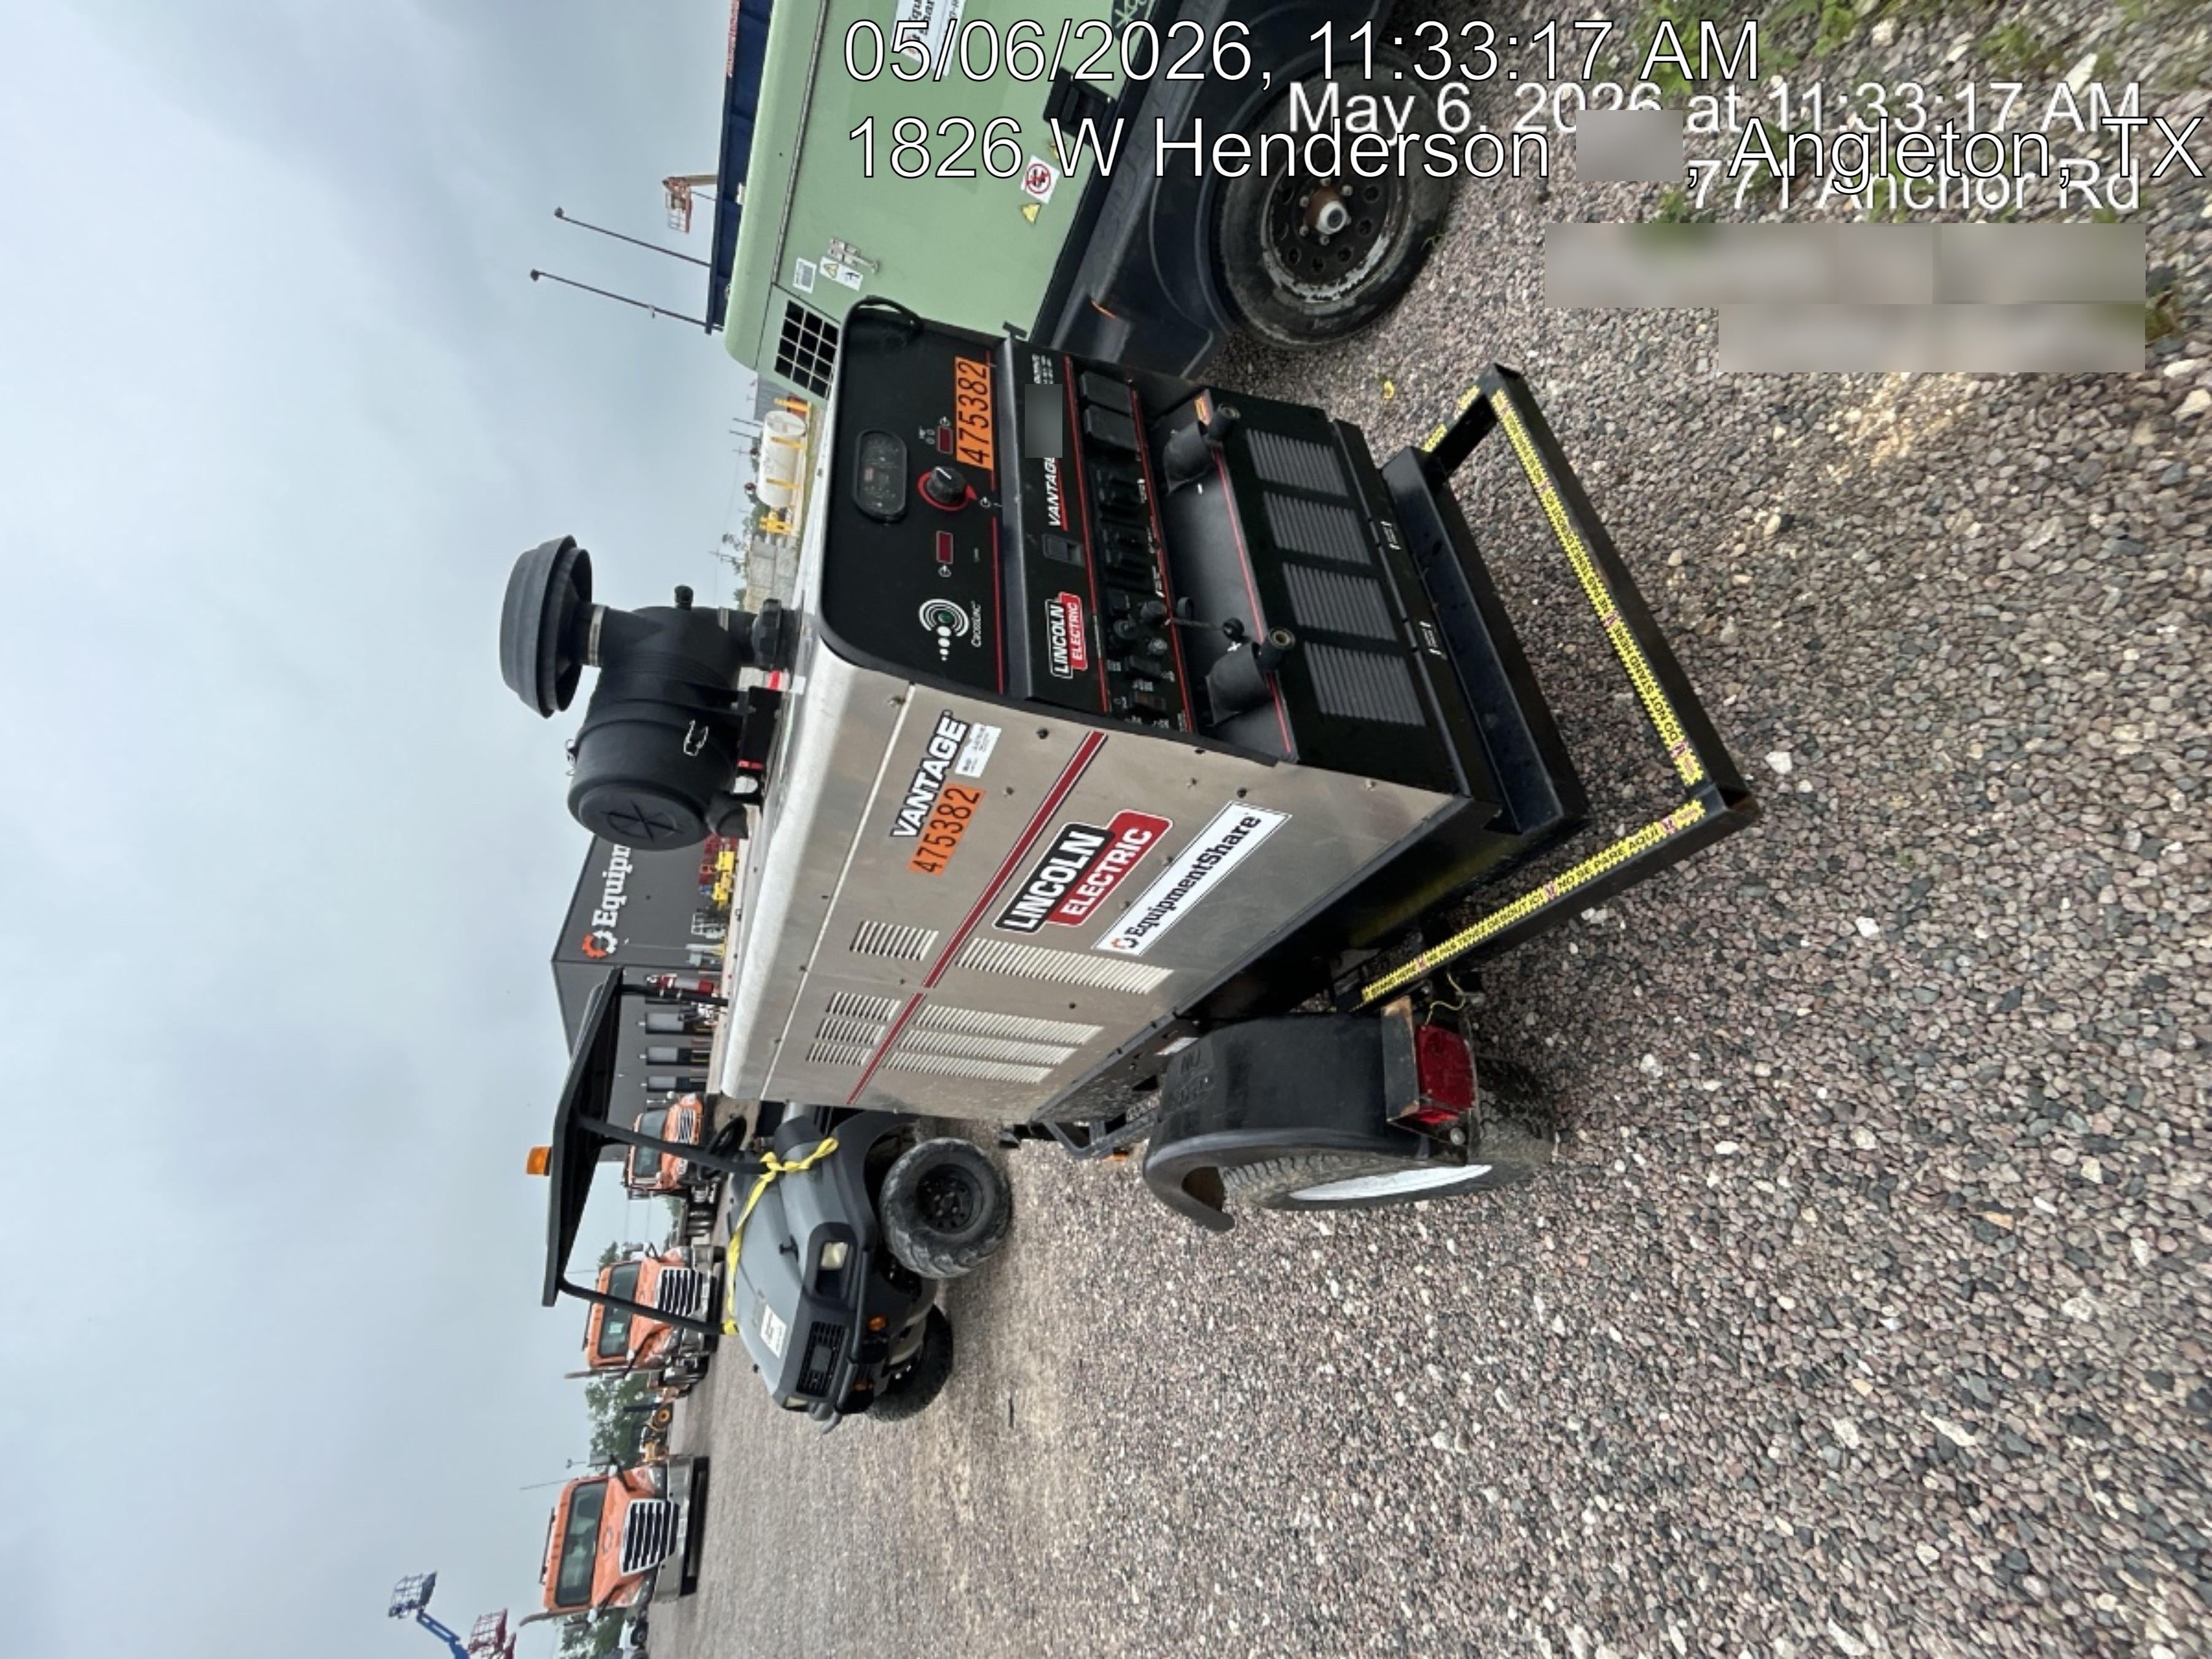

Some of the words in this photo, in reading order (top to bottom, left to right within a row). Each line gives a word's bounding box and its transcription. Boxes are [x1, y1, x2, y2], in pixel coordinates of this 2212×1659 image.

[957, 361, 991, 465] 475382
[1049, 603, 1070, 673] LINCOLN
[1067, 601, 1083, 661] ELECTRIC
[1612, 624, 1634, 655] HERE
[1629, 654, 1654, 695] STAND
[1649, 694, 1669, 720] NOT
[1664, 721, 1679, 742] DO
[890, 718, 968, 836] VANTAGE
[912, 785, 981, 872] 475382
[1003, 829, 1106, 928] LINCOLN
[1059, 827, 1153, 916] ELECTRIC
[1124, 815, 1261, 937] EquipmentShare
[1557, 874, 1575, 888] NO
[1594, 845, 1626, 866] PARE
